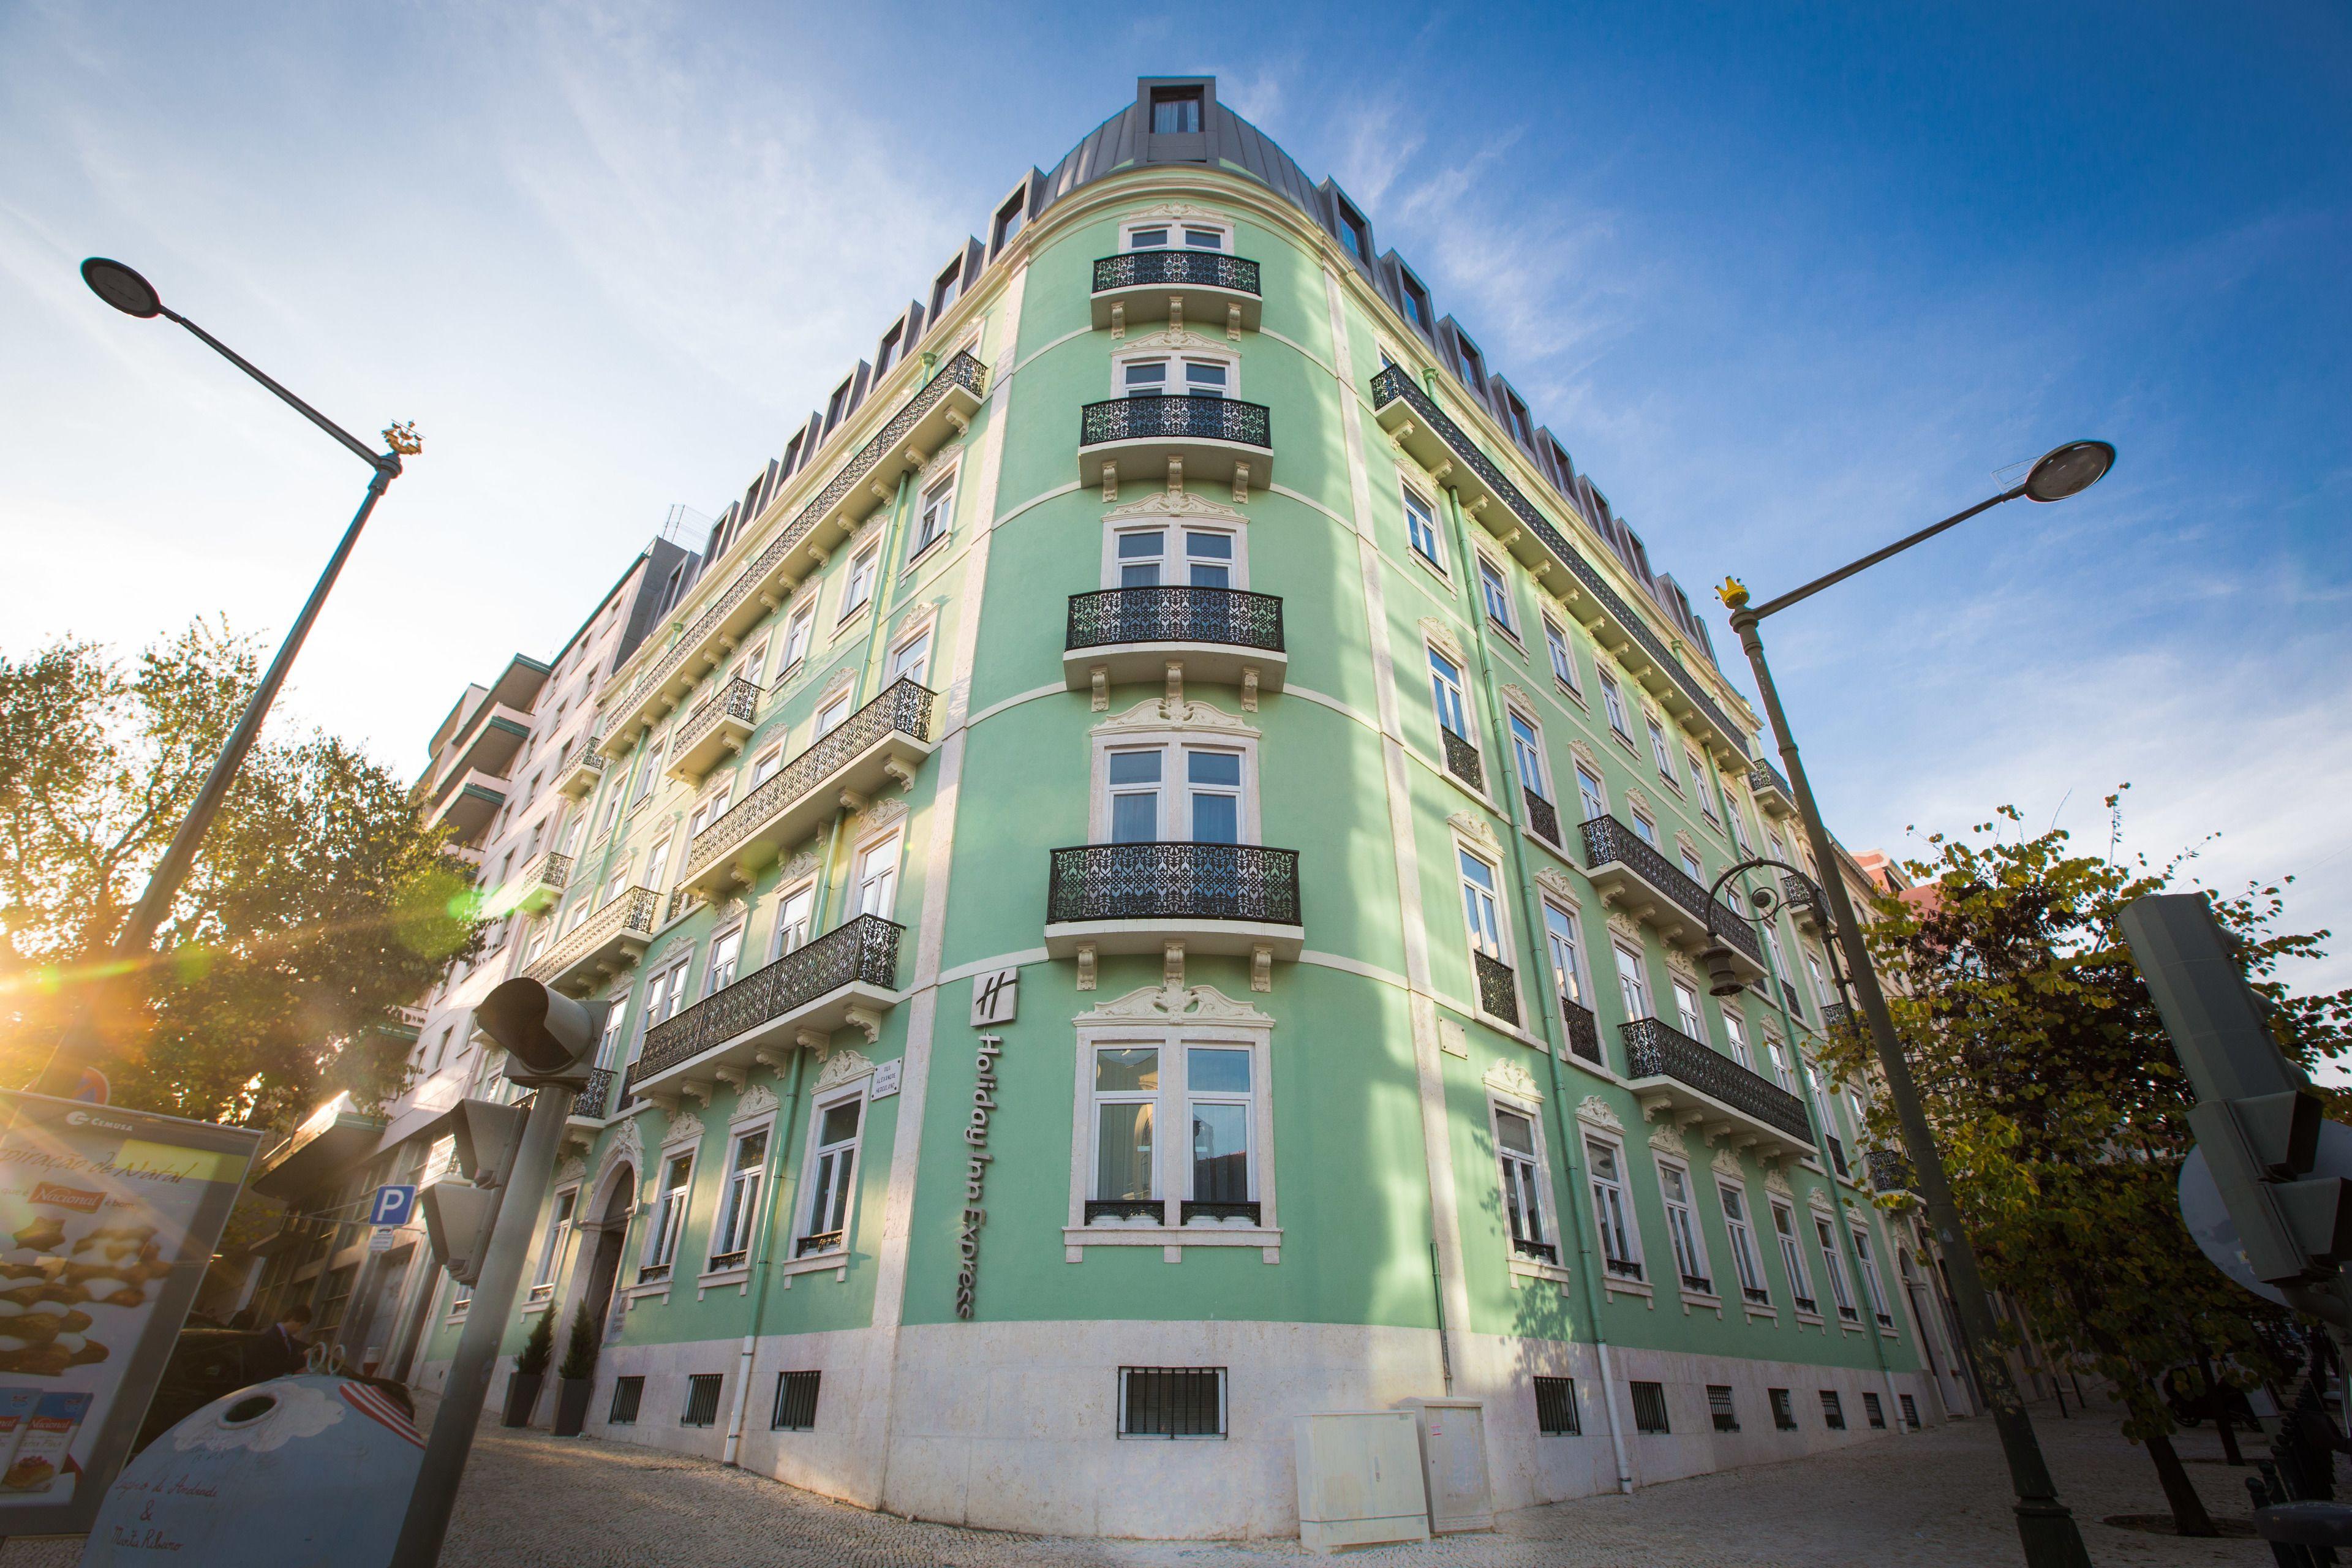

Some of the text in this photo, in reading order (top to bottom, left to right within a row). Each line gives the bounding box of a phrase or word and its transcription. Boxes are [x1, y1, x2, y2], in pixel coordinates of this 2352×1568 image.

[113, 1161, 199, 1184] Natal
[954, 1032, 1003, 1319] Holiday Inn Express
[34, 1186, 100, 1207] Nacional
[376, 1189, 404, 1221] P
[31, 1417, 70, 1429] Nacional
